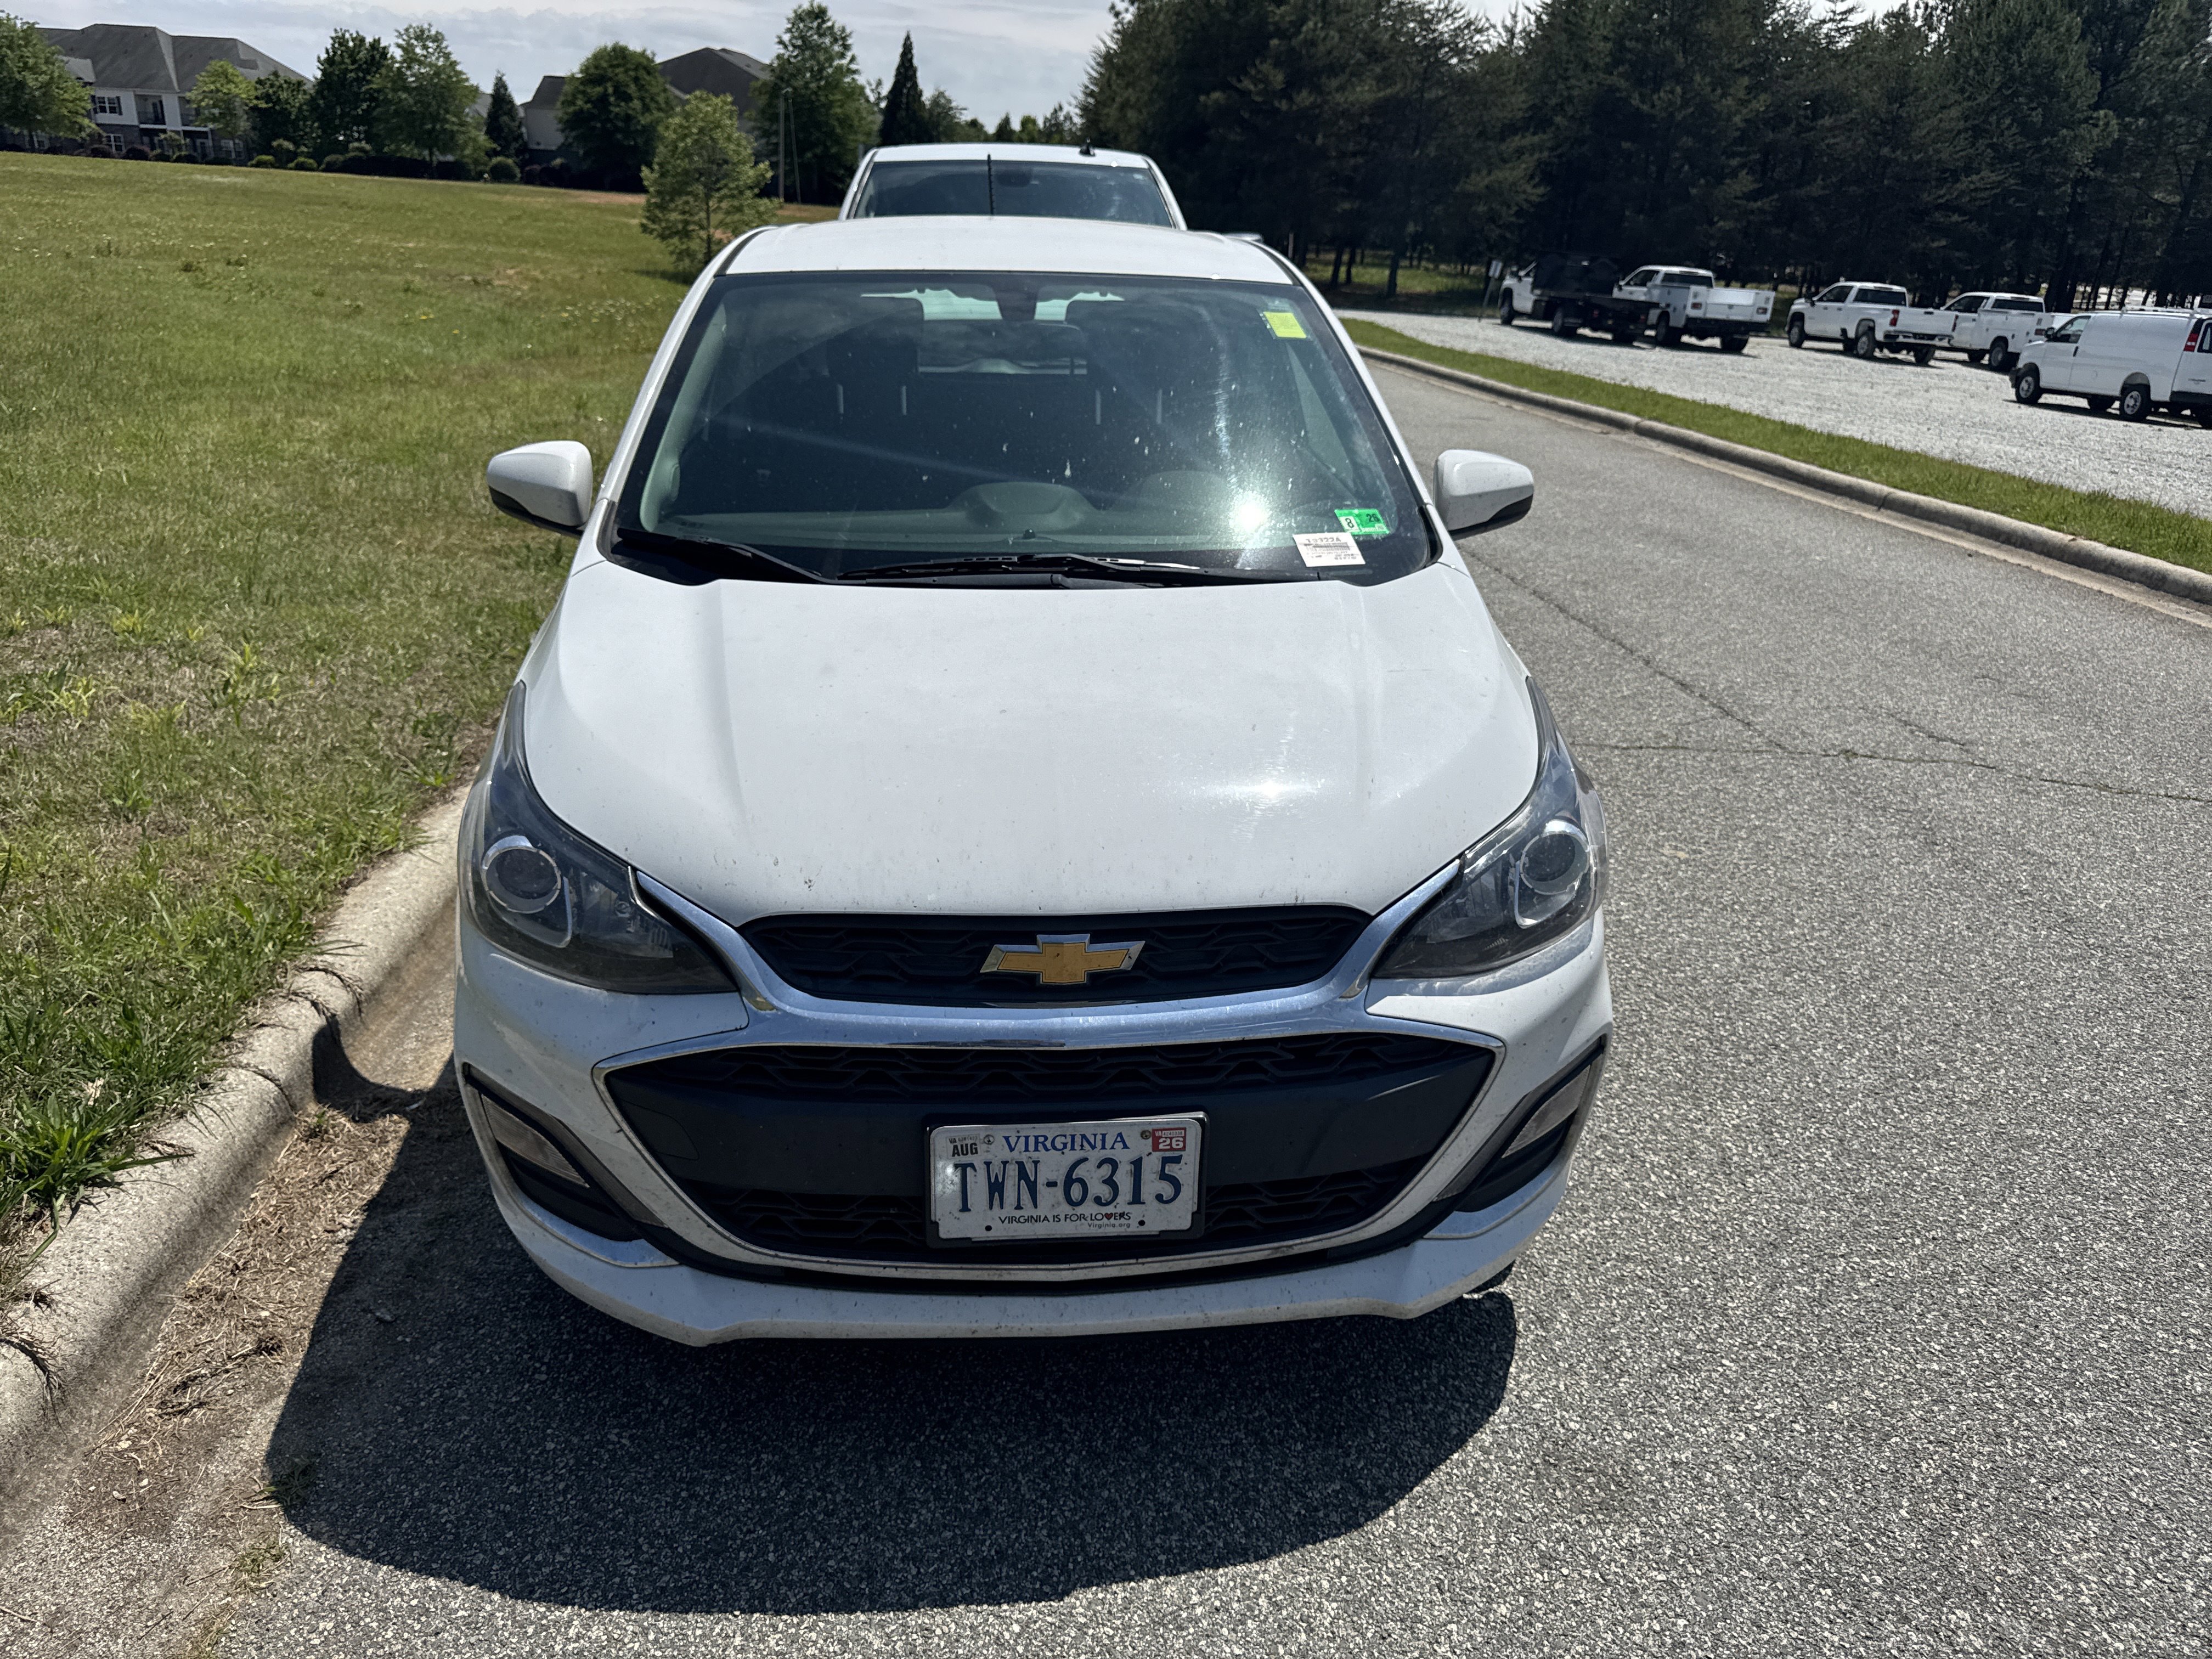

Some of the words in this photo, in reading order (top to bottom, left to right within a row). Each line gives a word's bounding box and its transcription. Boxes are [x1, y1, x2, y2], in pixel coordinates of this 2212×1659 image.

[1345, 518, 1355, 528] 8
[1002, 1131, 1131, 1153] VIRGINIA
[1159, 1137, 1184, 1149] 26
[952, 1142, 978, 1157] AUG
[953, 1154, 1184, 1212] TWN-6315
[998, 1214, 1051, 1224] VIRGINIA
[1053, 1214, 1061, 1223] IS
[1064, 1213, 1087, 1222] FOR
